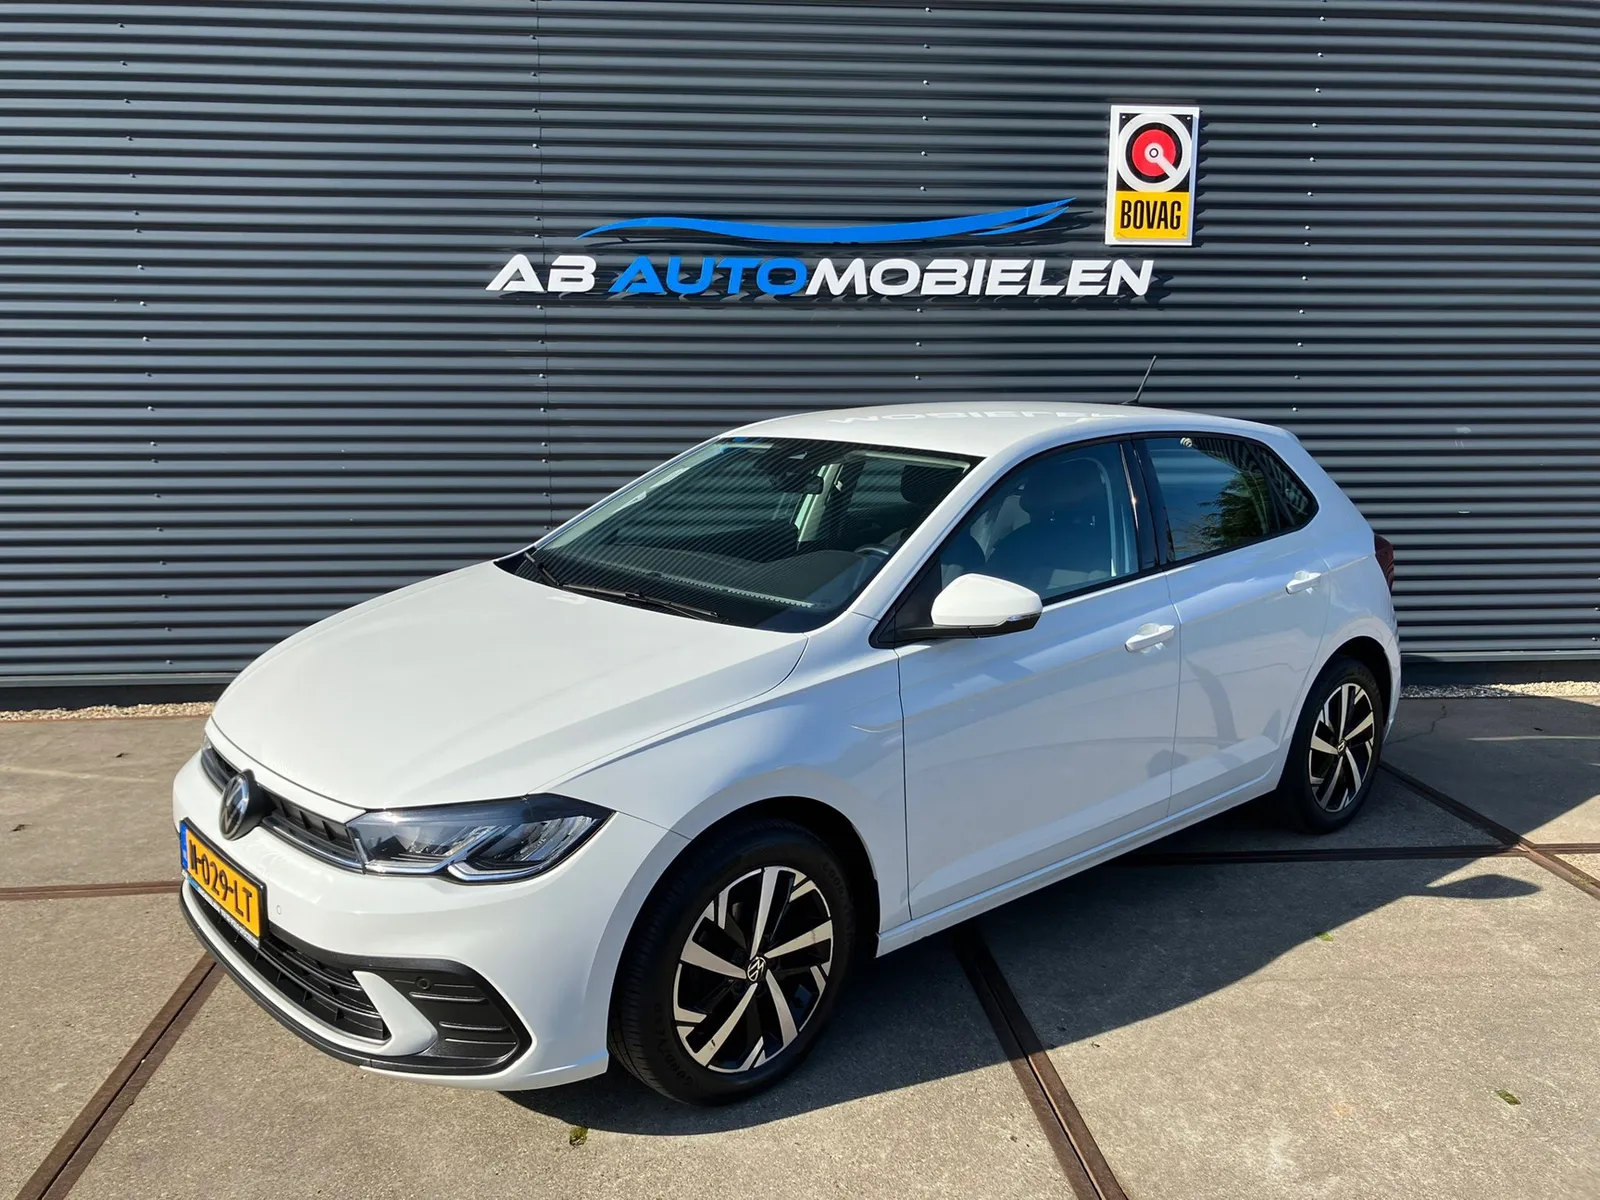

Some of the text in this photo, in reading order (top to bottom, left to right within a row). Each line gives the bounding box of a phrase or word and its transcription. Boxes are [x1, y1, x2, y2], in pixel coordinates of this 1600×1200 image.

[1119, 199, 1182, 231] BOVAG
[485, 253, 1155, 297] AB AUTOMOBIELEN
